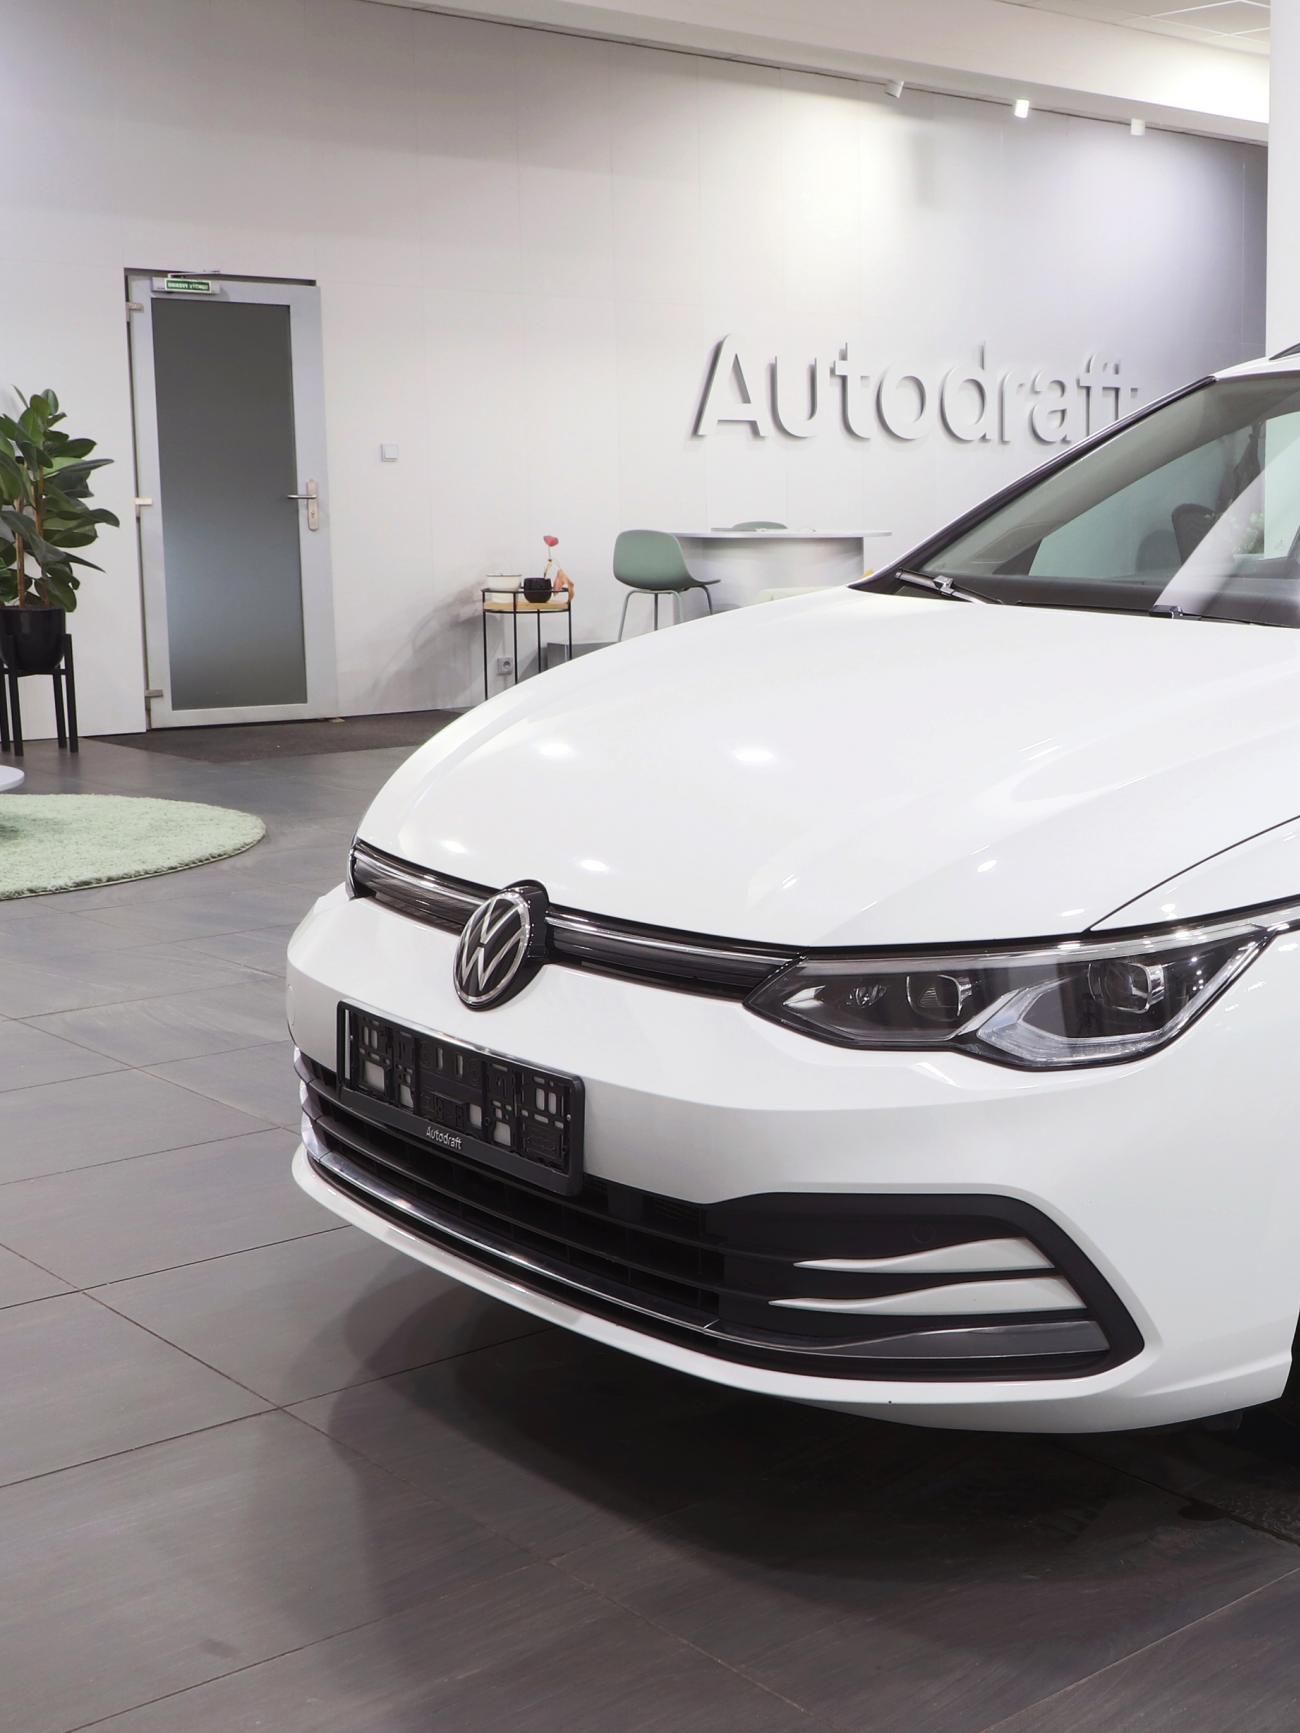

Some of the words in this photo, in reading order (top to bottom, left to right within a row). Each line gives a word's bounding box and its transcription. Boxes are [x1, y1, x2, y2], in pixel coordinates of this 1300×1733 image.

[690, 333, 1137, 444] Autodraft
[457, 892, 528, 995] VW
[426, 1126, 462, 1150] Autodraft
